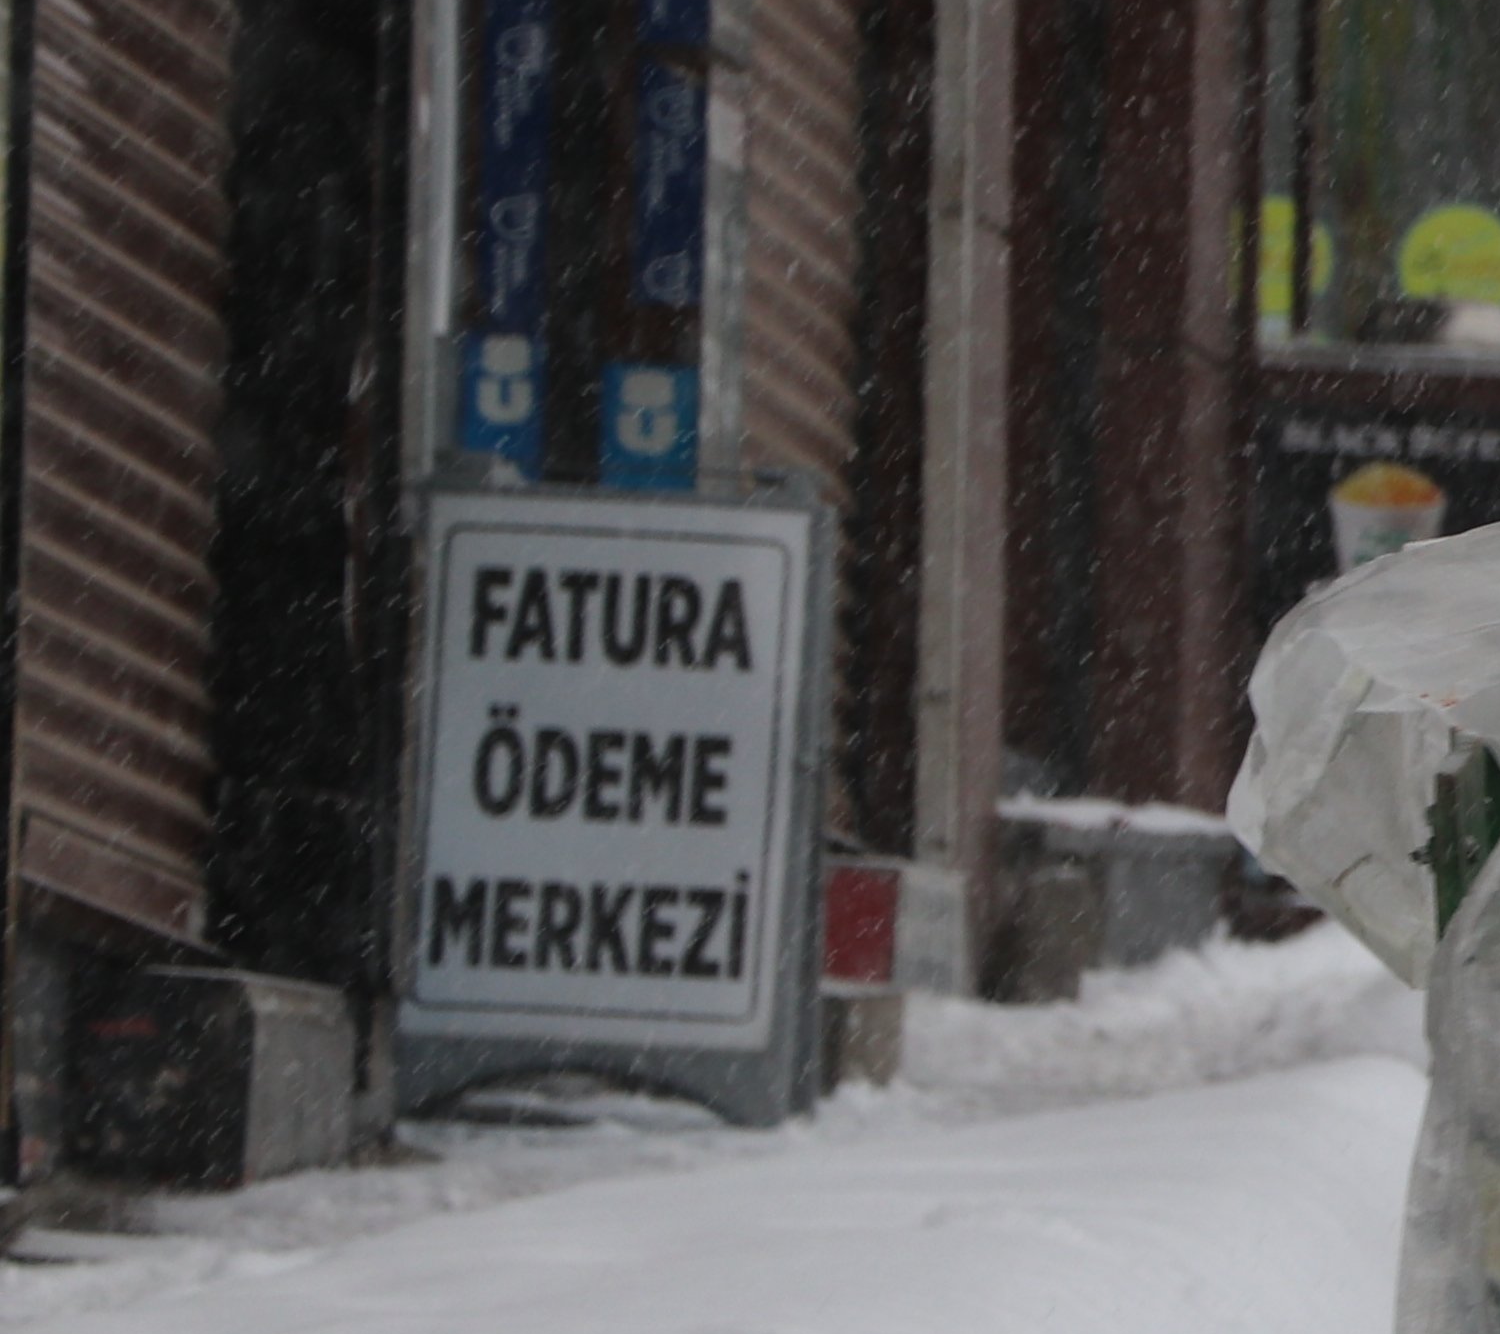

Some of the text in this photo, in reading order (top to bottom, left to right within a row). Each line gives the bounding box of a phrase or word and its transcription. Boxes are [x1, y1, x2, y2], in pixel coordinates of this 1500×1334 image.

[469, 565, 755, 670] FATURA
[472, 703, 733, 827] ÖDEME
[427, 870, 752, 980] MERKEZİ
